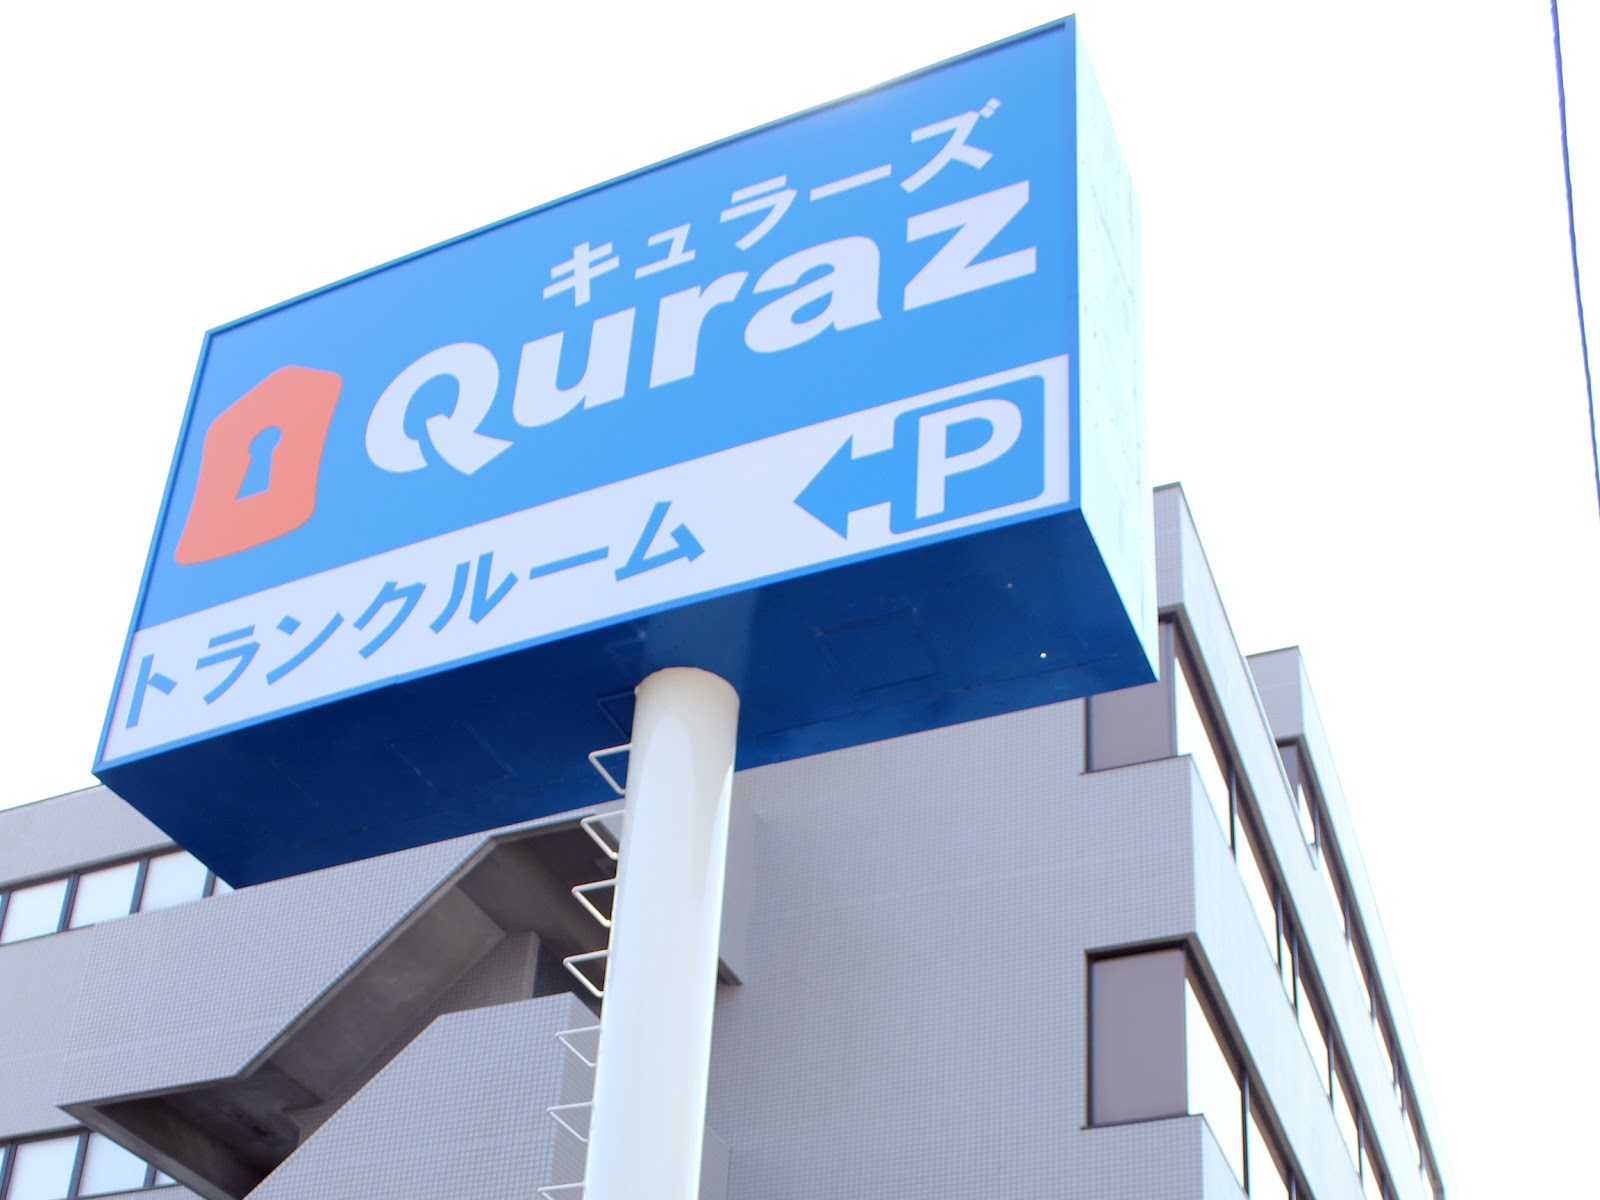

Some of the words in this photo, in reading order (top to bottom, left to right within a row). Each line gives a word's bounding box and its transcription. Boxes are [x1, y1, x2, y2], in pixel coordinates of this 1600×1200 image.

[543, 97, 1001, 307] キュラーズ
[365, 179, 1037, 476] Quraz
[915, 398, 1022, 520] P
[125, 500, 705, 729] トランクルーム
